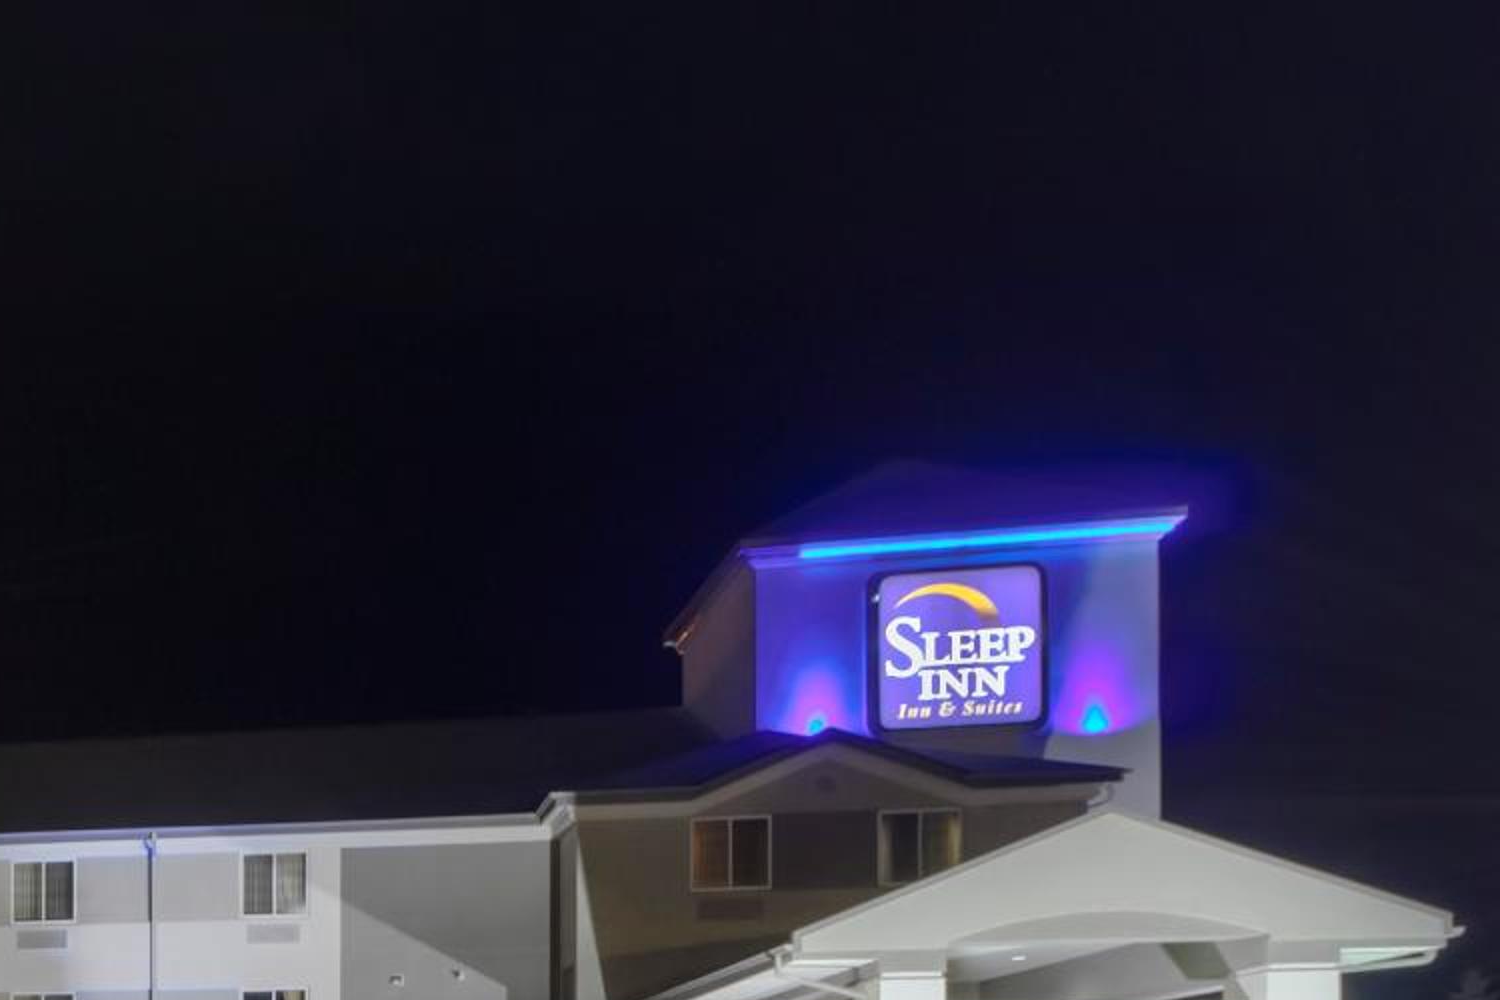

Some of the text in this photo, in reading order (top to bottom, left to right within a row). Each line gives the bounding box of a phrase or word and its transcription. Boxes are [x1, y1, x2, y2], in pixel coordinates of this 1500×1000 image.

[885, 616, 1036, 678] SLEEP
[917, 665, 1010, 701] INN
[898, 700, 1023, 720] Inn & Suites
